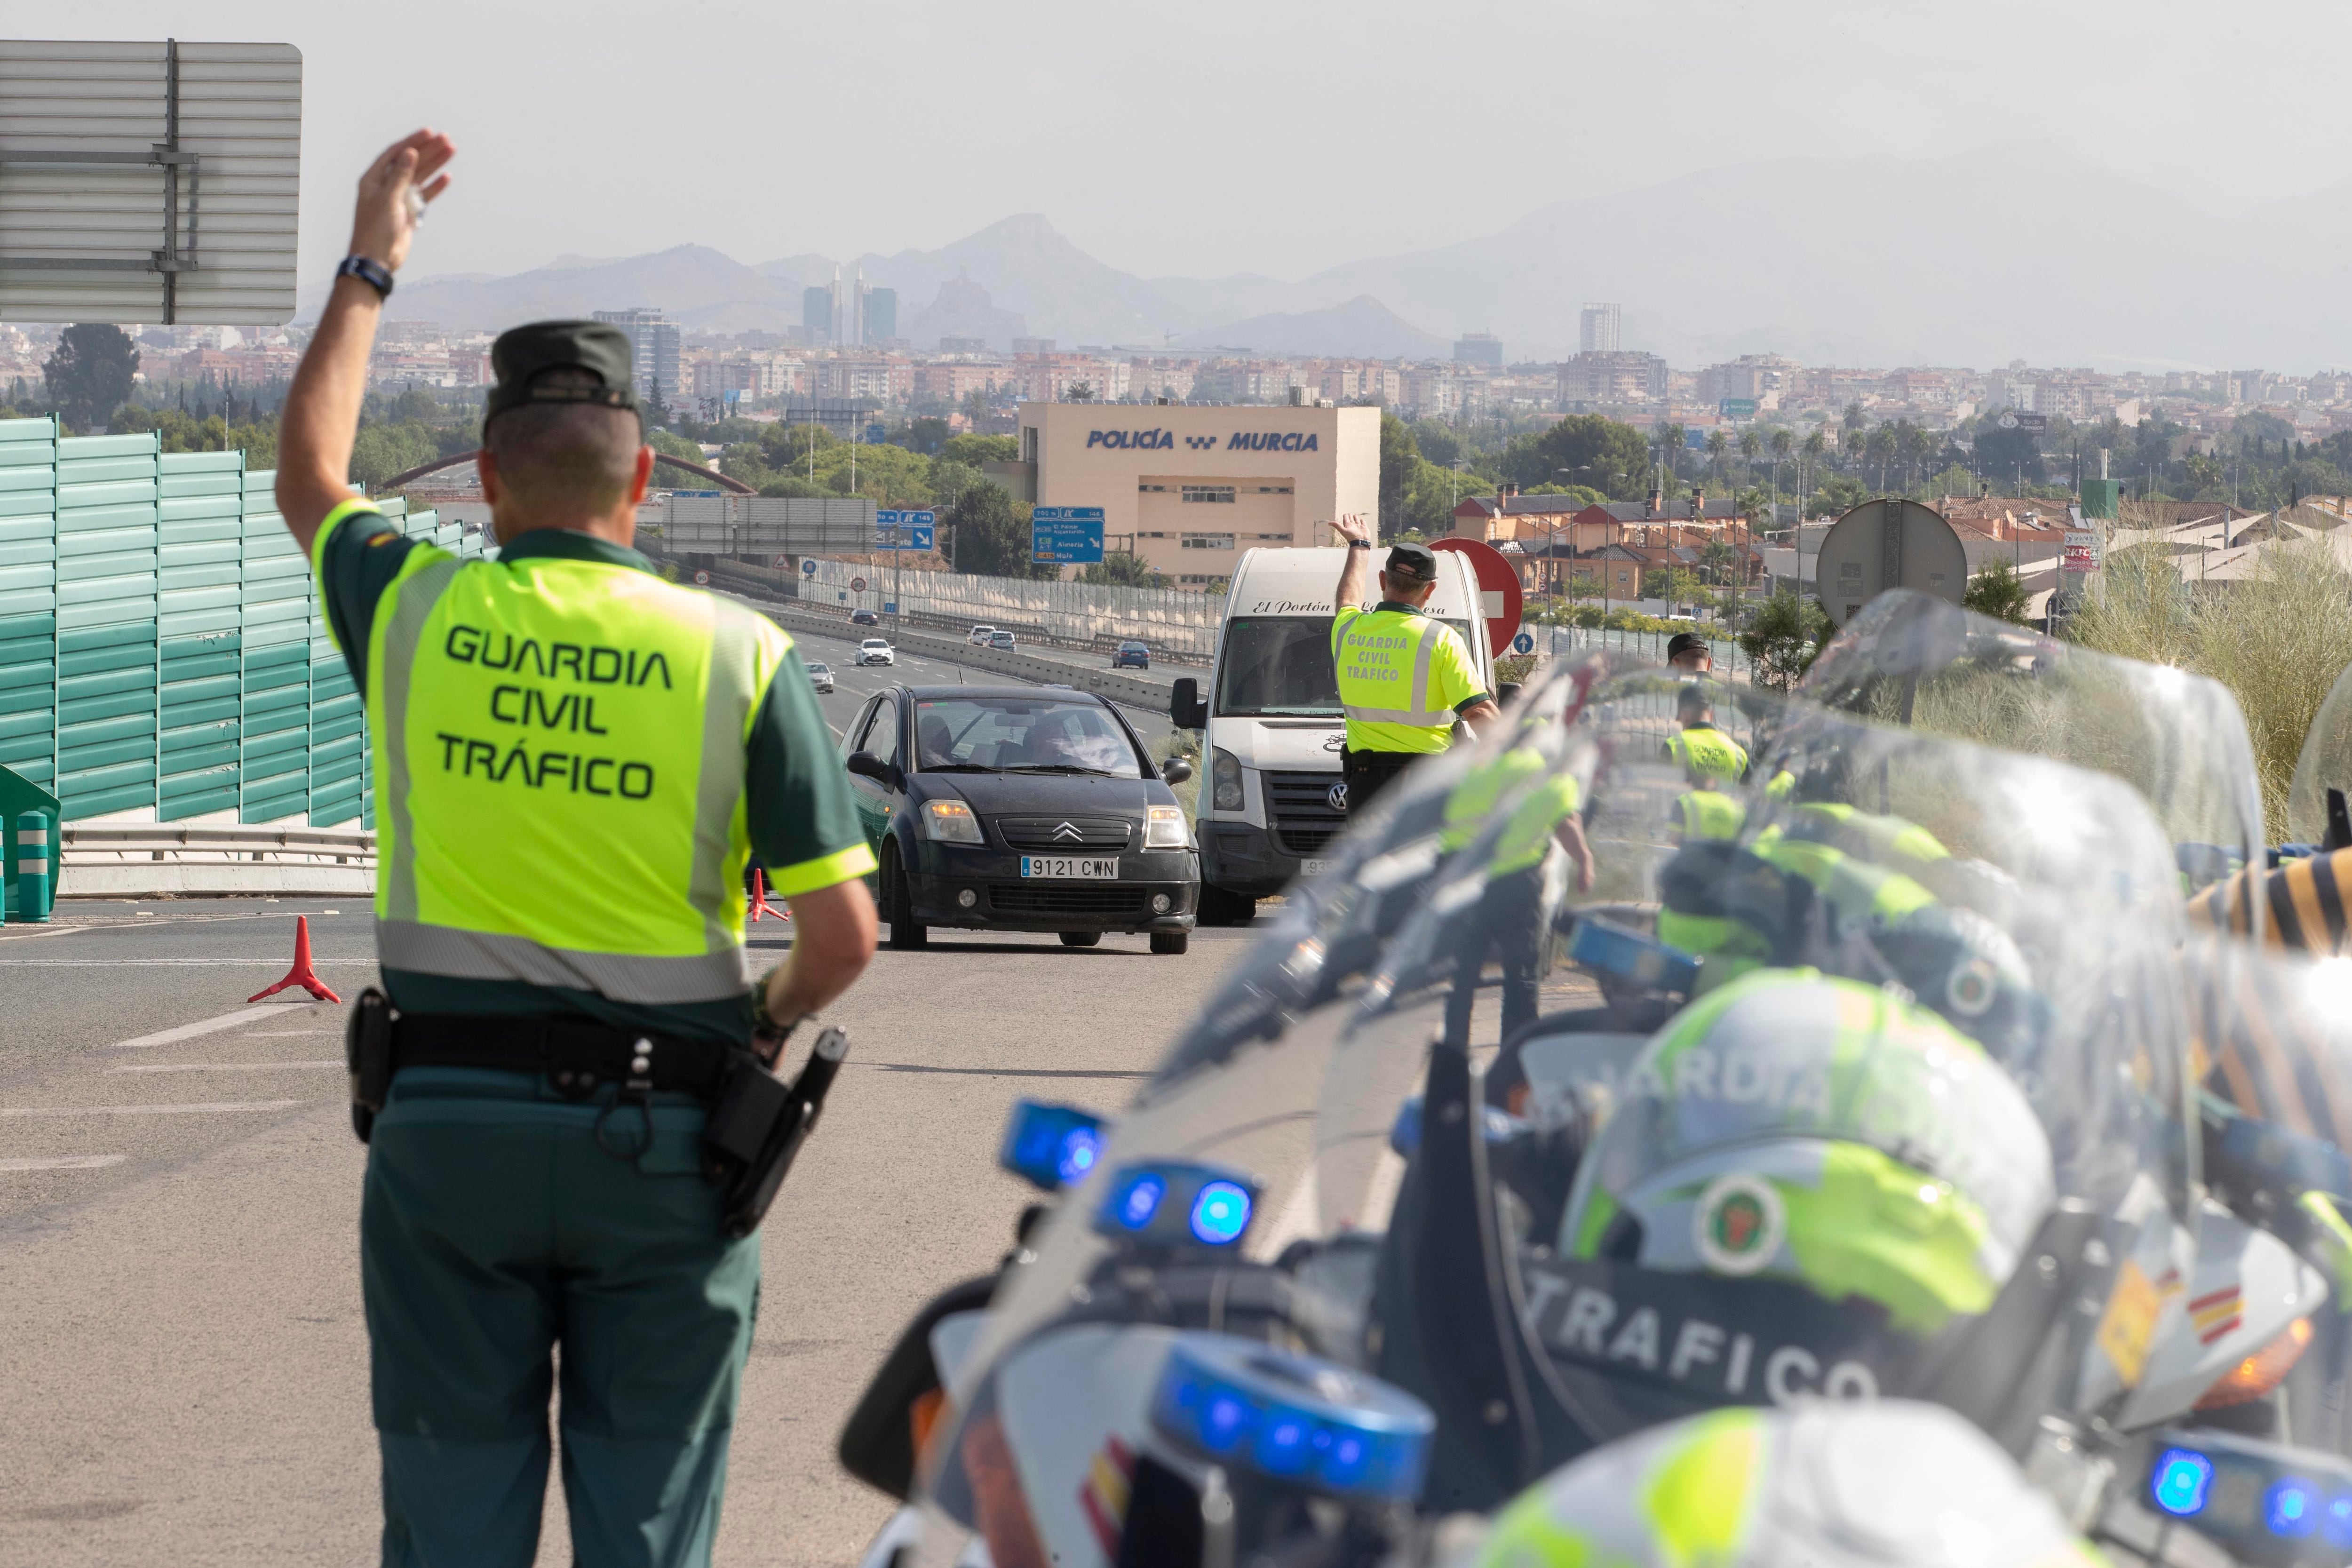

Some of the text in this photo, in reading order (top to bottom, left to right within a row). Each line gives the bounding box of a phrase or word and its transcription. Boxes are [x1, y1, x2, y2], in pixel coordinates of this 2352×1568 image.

[1086, 428, 1318, 451] POLICÍA MURCIA
[1253, 601, 1271, 613] El
[1275, 600, 1330, 613] Portón
[1347, 633, 1407, 649] GUARDIA
[445, 625, 673, 690] GUARDIA
[1358, 651, 1390, 665] CIVIL
[1347, 665, 1398, 681] TRAFICO
[490, 685, 608, 735] CIVIL
[437, 731, 654, 800] TRÁFICO
[1033, 859, 1113, 876] 9121 CWN
[1521, 1266, 1881, 1408] TRAFICO
